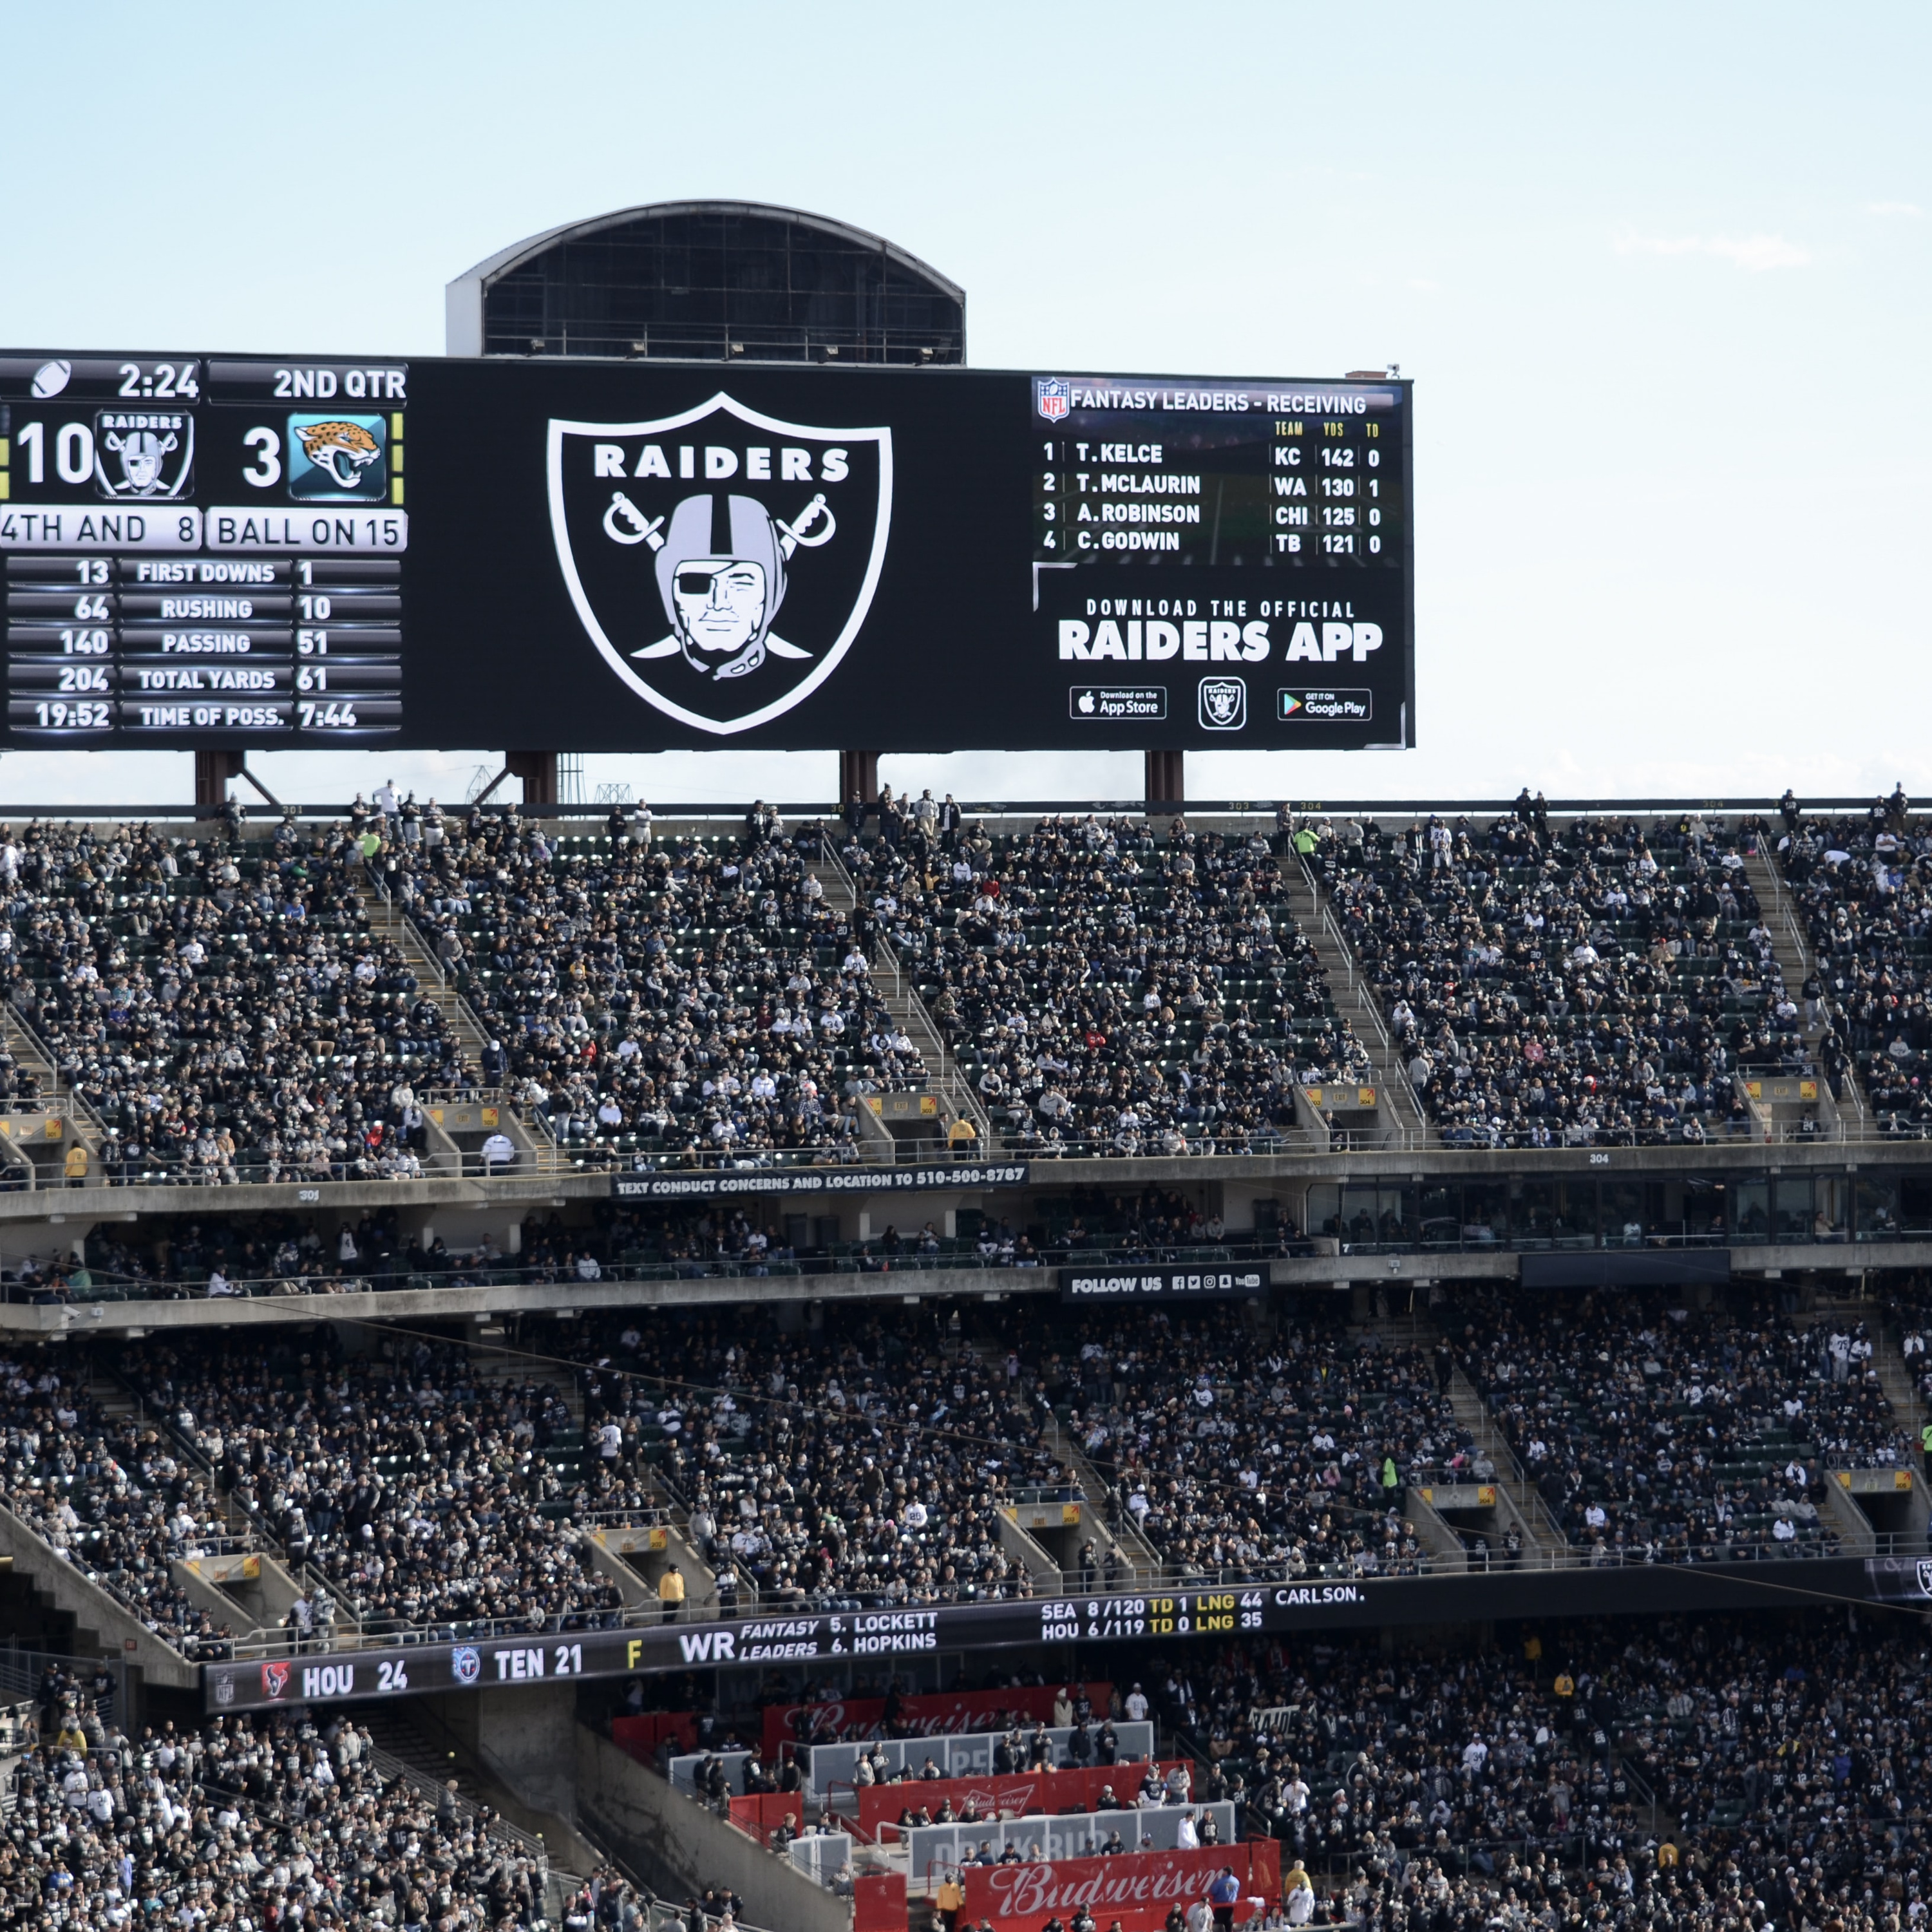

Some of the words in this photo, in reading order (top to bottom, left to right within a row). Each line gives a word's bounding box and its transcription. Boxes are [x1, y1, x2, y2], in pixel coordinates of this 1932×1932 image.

[118, 363, 199, 398] 2:24
[274, 370, 337, 398] 2ND
[344, 370, 406, 399] QTR
[1043, 397, 1066, 414] NFL
[1070, 389, 1157, 411] FANTASY
[1162, 392, 1249, 412] LEADERS
[1267, 395, 1367, 415] RECEIVING
[102, 414, 183, 430] RAIDERS
[1275, 421, 1303, 436] TEAM
[1323, 422, 1344, 437] YDS
[1367, 424, 1379, 438] TD
[17, 421, 95, 484] 10
[243, 426, 282, 488] 3
[594, 444, 849, 482] RAIDERS
[1044, 442, 1053, 460] 1
[1275, 448, 1301, 466] KC
[1321, 448, 1354, 467] 142
[1368, 450, 1379, 468] 0
[1043, 473, 1055, 491] 2
[1274, 477, 1307, 496] WA
[1322, 478, 1354, 497] 130
[1369, 479, 1378, 497] 1
[1044, 503, 1056, 521] 3
[1275, 507, 1308, 525] CHI
[1322, 507, 1354, 526] 125
[1369, 508, 1380, 526] 0
[1, 515, 62, 542] 4TH
[77, 515, 146, 542] AND
[178, 516, 196, 543] 8
[218, 518, 301, 545] BALL
[313, 518, 355, 545] ON
[366, 520, 399, 547] 15
[1043, 531, 1056, 549] 4
[1276, 535, 1301, 553] TB
[1322, 535, 1354, 553] 121
[1369, 535, 1380, 553] 0
[77, 560, 109, 585] 13
[137, 564, 196, 583] FIRST
[201, 564, 275, 583] DOWNS
[299, 561, 312, 585] 1
[75, 596, 109, 620] 64
[161, 600, 252, 619] RUSHING
[300, 596, 330, 620] 10
[1087, 598, 1197, 617] DOWNLOAD
[1211, 600, 1247, 617] THE
[1260, 601, 1355, 618] OFFICIAL
[60, 630, 109, 654] 140
[162, 634, 251, 654] PASSING
[298, 630, 328, 655] 51
[1059, 620, 1271, 662] RAIDERS
[1285, 622, 1383, 661] APP
[59, 667, 109, 691] 204
[140, 670, 204, 690] TOTAL
[210, 670, 276, 690] YARDS
[296, 667, 327, 691] 61
[35, 702, 109, 727] 19:52
[141, 707, 191, 726] TIME
[195, 707, 221, 726] OF
[225, 707, 285, 727] POSS.
[299, 702, 357, 727] 7:44
[1100, 700, 1124, 716] App
[1126, 700, 1159, 714] Store
[1305, 701, 1343, 716] Google
[1344, 701, 1365, 717] Play
[283, 806, 303, 814] 301
[1229, 802, 1249, 810] 303
[1300, 802, 1321, 810] 304
[1703, 800, 1724, 808] 304
[1434, 831, 1444, 840] 24
[837, 925, 848, 935] 20
[864, 920, 874, 930] 34
[1803, 1121, 1814, 1131] 24
[1589, 1153, 1609, 1164] 304
[618, 1182, 649, 1195] TEXT
[652, 1180, 715, 1193] CONDUCT
[719, 1178, 790, 1191] CONCERNS
[792, 1177, 822, 1189] AND
[826, 1174, 892, 1188] LOCATION
[896, 1173, 913, 1186] TO
[916, 1168, 1025, 1185] 510-500-8787
[299, 1189, 319, 1202] 301
[1342, 1244, 1350, 1253] 7
[1072, 1278, 1137, 1293] FOLLOW
[1141, 1277, 1162, 1291] US
[1235, 1274, 1260, 1287] YouTube
[1041, 1604, 1076, 1620] SEA
[1087, 1602, 1099, 1617] 8
[1150, 1598, 1173, 1613] TD
[1180, 1597, 1188, 1612] 1
[1196, 1595, 1235, 1611] LNG
[1240, 1591, 1262, 1609] 44
[1275, 1586, 1365, 1605] CARLSON.
[739, 1620, 820, 1640] FANTASY
[829, 1616, 847, 1633] 5.
[854, 1612, 938, 1633] LOCKETT
[1041, 1622, 1079, 1641] HOU
[1088, 1621, 1099, 1637] 6
[1150, 1618, 1173, 1633] TD
[1178, 1616, 1189, 1633] 0
[1196, 1615, 1234, 1631] LNG
[1240, 1612, 1262, 1629] 35
[627, 1640, 642, 1669] F
[679, 1632, 735, 1663] WR
[739, 1641, 818, 1662] LEADERS
[831, 1638, 848, 1653] 6.
[853, 1633, 937, 1653] HOPKINS
[495, 1648, 544, 1680] TEN
[554, 1643, 582, 1674] 21
[302, 1663, 354, 1699] HOU
[377, 1660, 408, 1692] 24
[1752, 1703, 1763, 1713] 24
[1772, 1703, 1784, 1714] 98
[1614, 1781, 1625, 1793] 28
[1772, 1774, 1785, 1786] 20
[1797, 1772, 1807, 1783] 12
[1233, 1792, 1245, 1803] 24
[1870, 1785, 1883, 1796] 75
[394, 1831, 406, 1844] 16
[990, 1863, 1226, 1915] Budweiser
